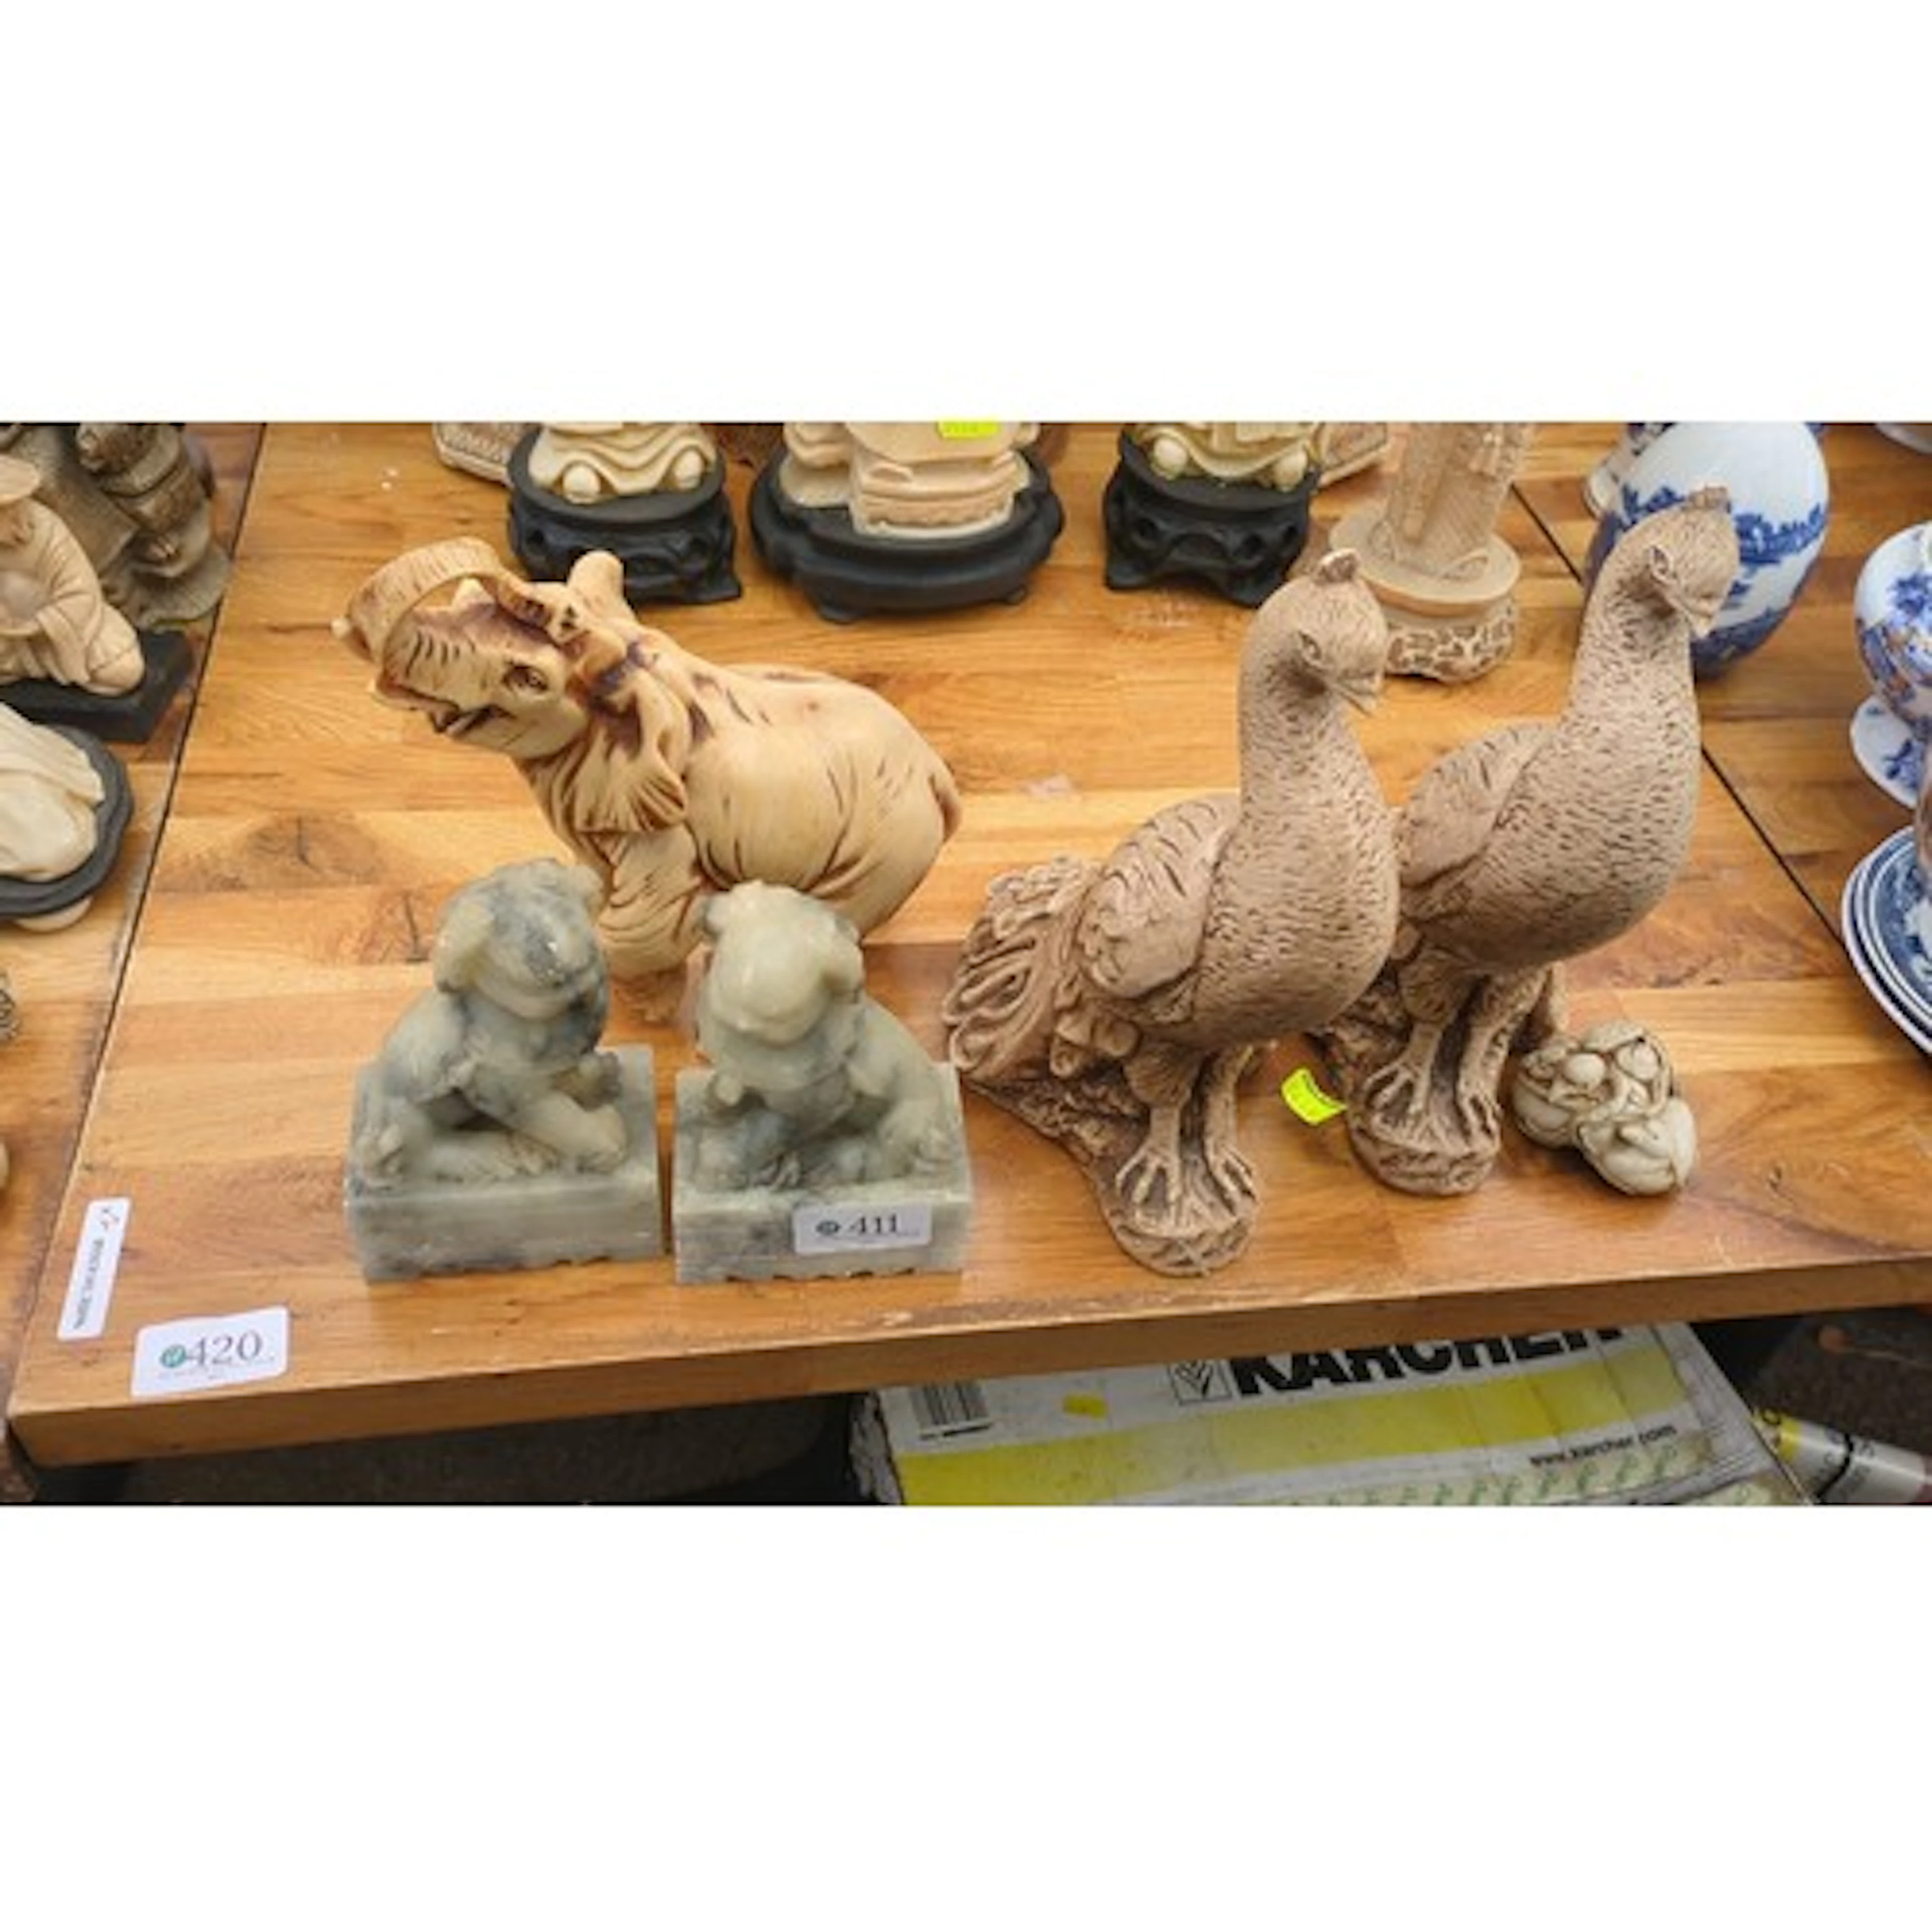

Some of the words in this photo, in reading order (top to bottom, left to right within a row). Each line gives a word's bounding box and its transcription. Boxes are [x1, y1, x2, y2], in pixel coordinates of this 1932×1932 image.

[847, 1213, 897, 1234] 411
[185, 1330, 263, 1365] 420
[1231, 1327, 1622, 1395] KARCH
